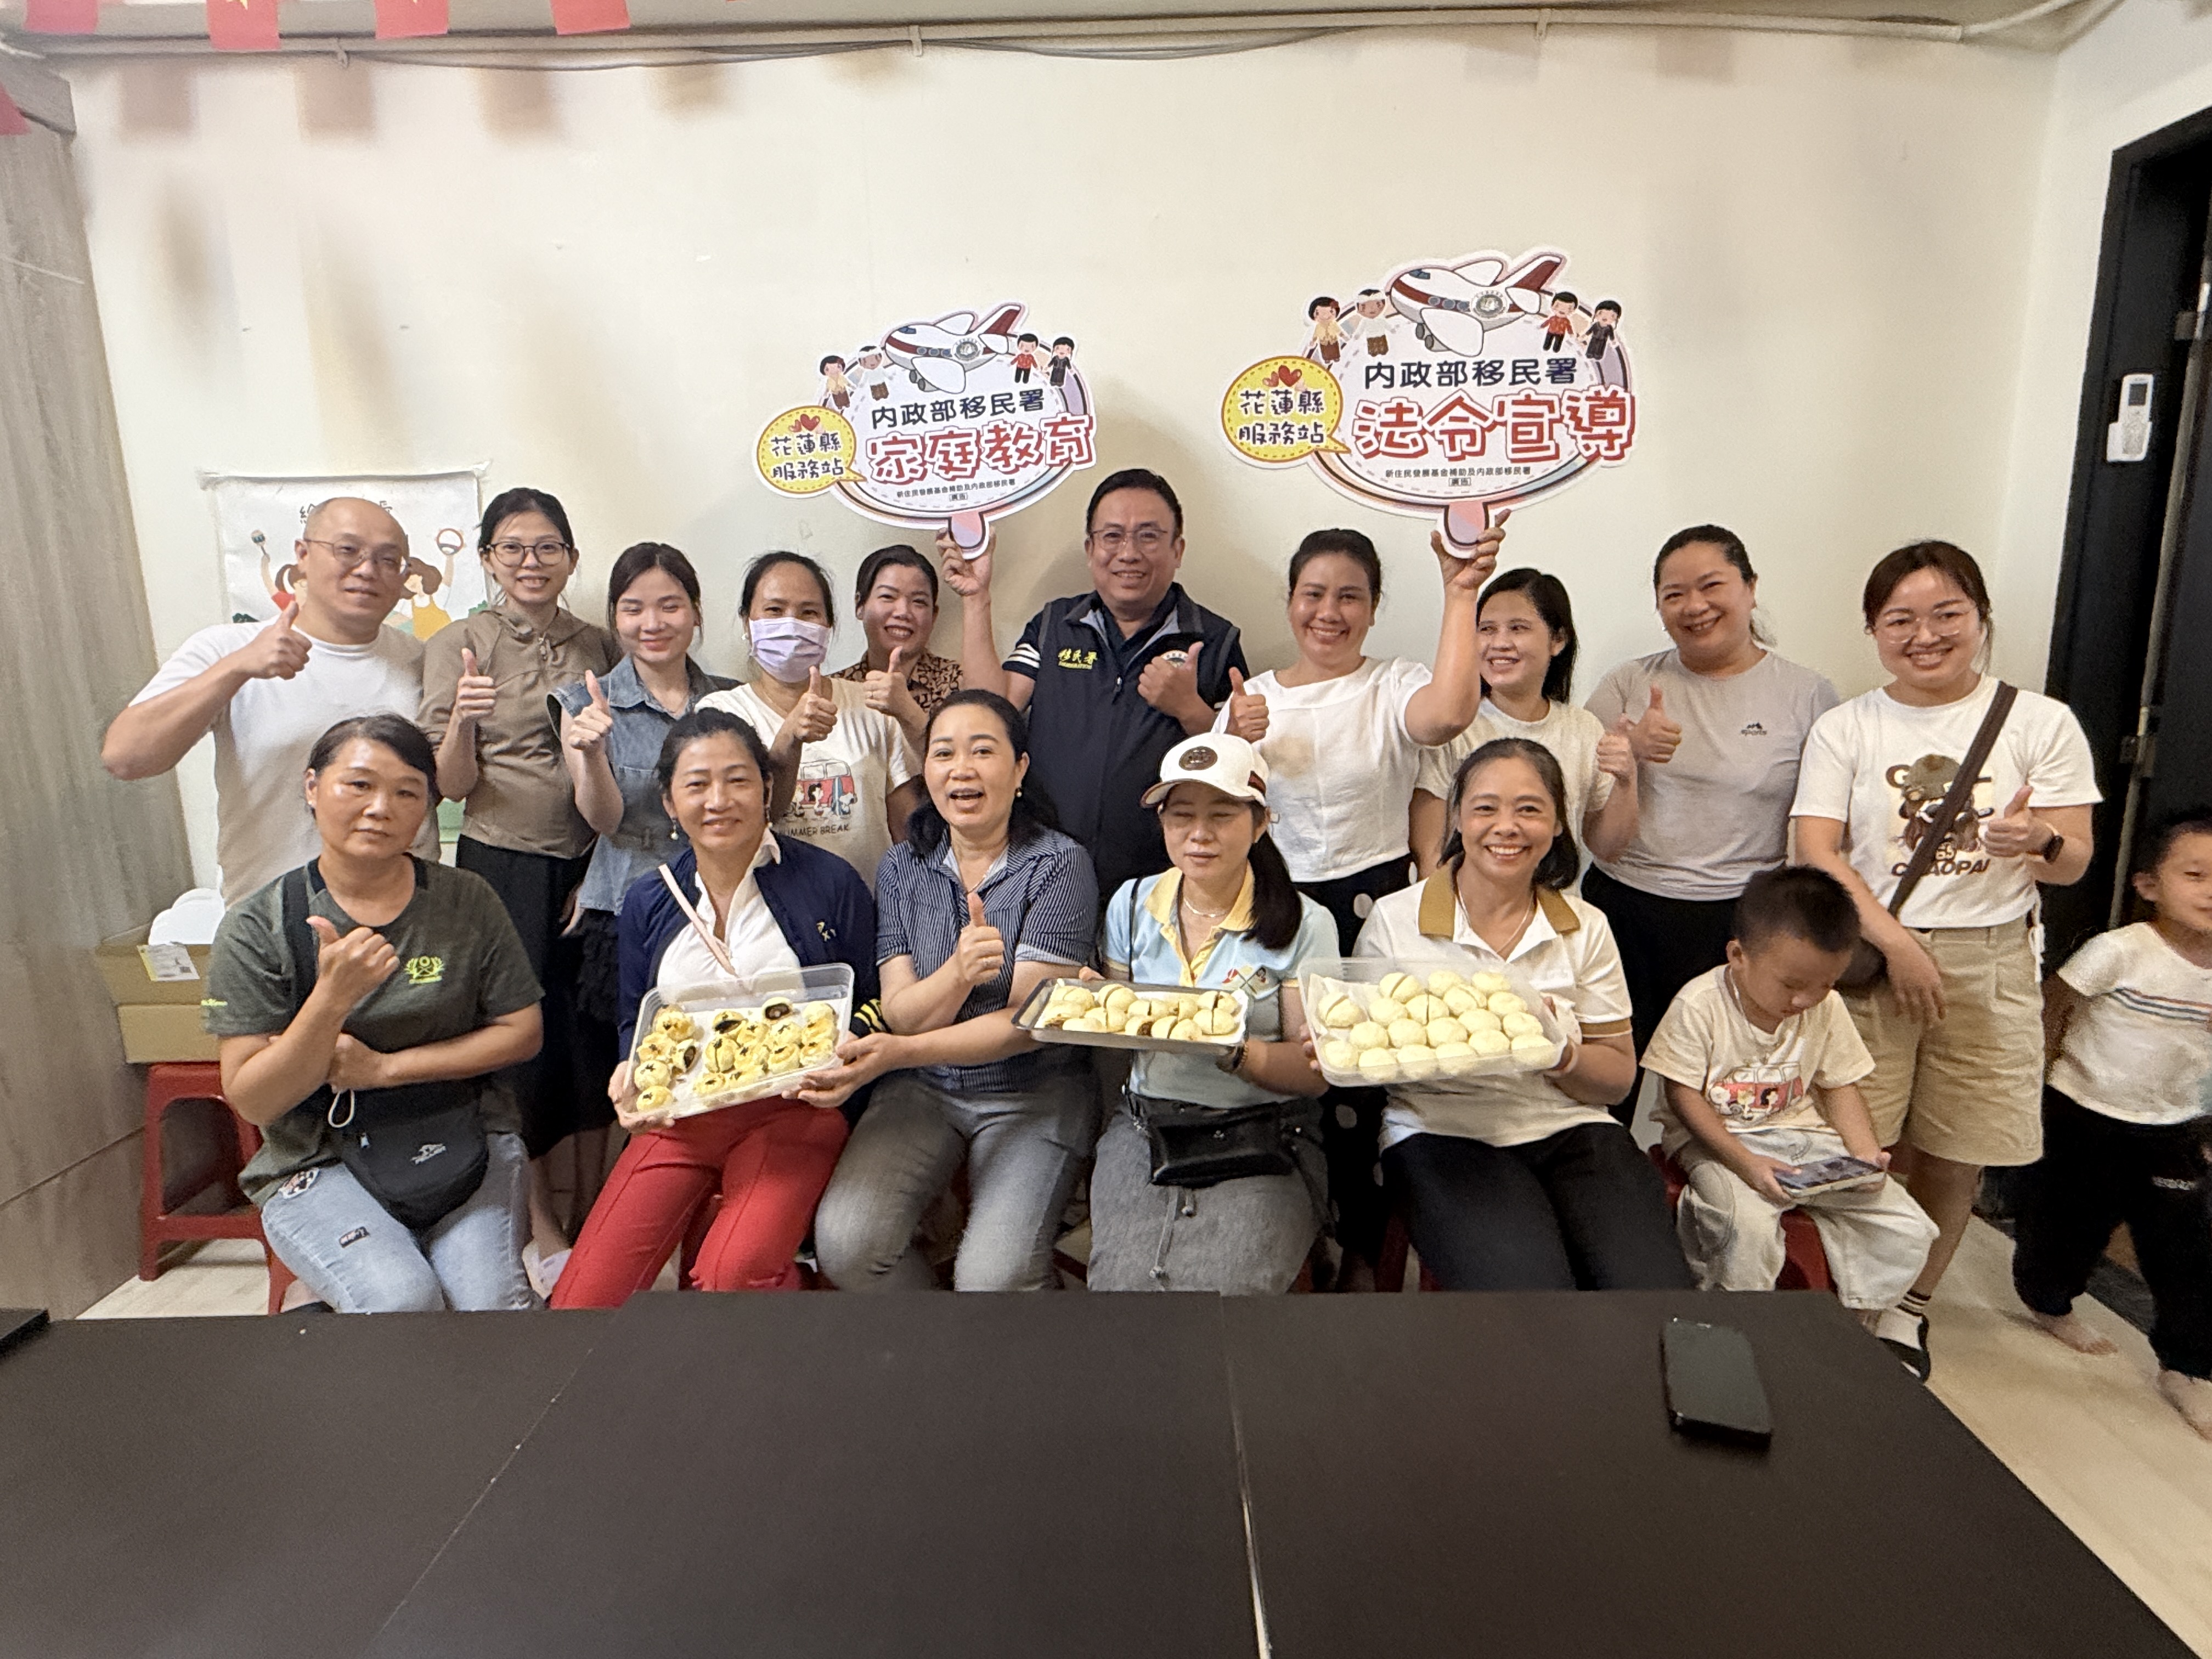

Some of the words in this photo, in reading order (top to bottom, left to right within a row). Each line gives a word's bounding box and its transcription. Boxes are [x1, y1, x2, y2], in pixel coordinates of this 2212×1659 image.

[1240, 389, 1324, 414] 花蓮縣
[1239, 421, 1324, 445] 服務站
[1353, 386, 1634, 463] 法令宣導
[770, 432, 842, 456] 花蓮縣
[867, 413, 1095, 485] 家庭教育
[772, 458, 844, 481] 服務站
[779, 826, 817, 838] UMMER
[820, 823, 850, 834] BREAK
[1891, 858, 1991, 876] CAOPAI
